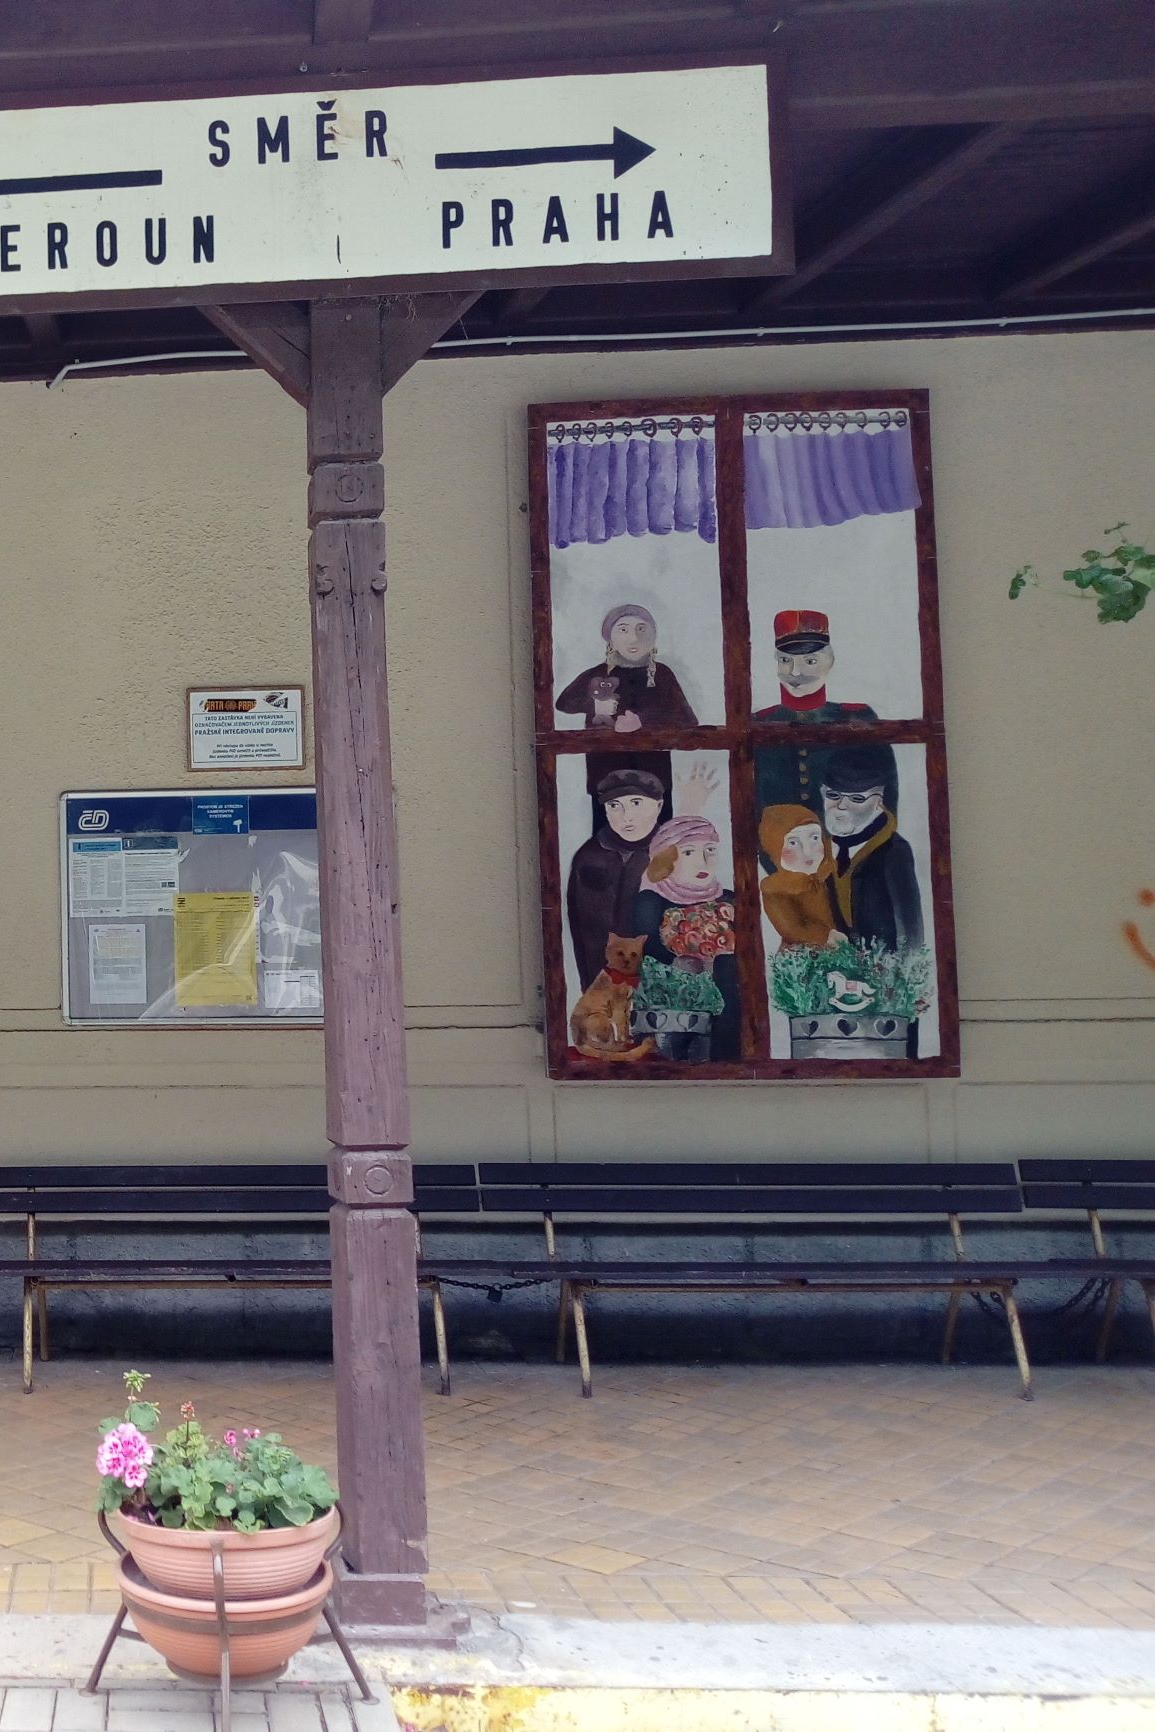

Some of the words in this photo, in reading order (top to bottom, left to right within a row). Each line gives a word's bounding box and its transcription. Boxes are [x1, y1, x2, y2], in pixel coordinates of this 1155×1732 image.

[208, 98, 389, 168] SMĚR
[442, 191, 675, 249] PRAHA
[222, 727, 264, 735] INTEGROVANÉ
